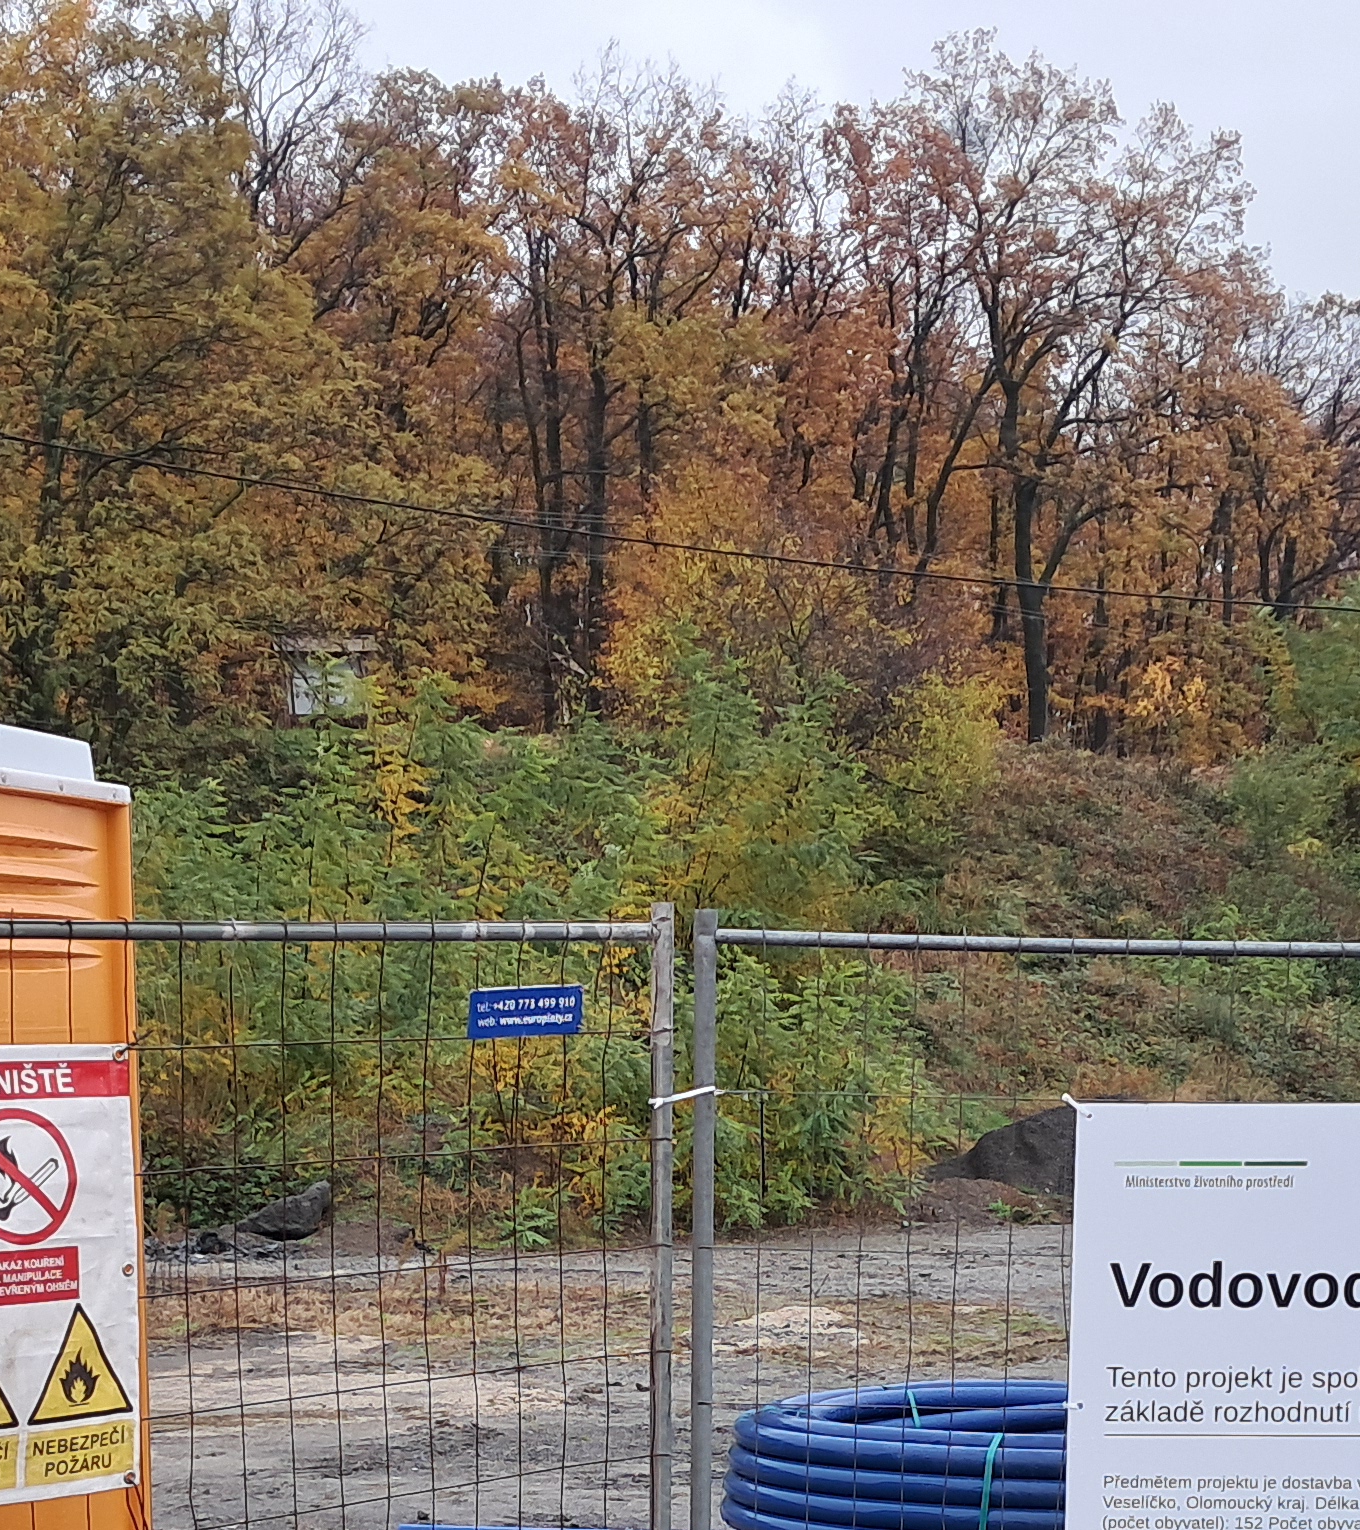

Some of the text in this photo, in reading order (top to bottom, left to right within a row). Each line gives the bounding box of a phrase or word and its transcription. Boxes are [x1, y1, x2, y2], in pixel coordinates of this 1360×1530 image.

[1126, 1175, 1293, 1190] Ministerstvo životního prostředí
[24, 1255, 64, 1269] KOUŘENÍ
[3, 1270, 63, 1282] MANIPULACE
[1106, 1367, 1175, 1387] Tento
[1186, 1366, 1272, 1393] projekt
[1279, 1366, 1302, 1393] je
[1105, 1400, 1203, 1422] základě
[1215, 1401, 1351, 1422] rozhodnutí
[32, 1426, 126, 1457] NEBEZPEČÍ
[45, 1453, 112, 1477] POŽÁRU
[1104, 1475, 1191, 1488] Předmětem
[1198, 1475, 1258, 1492] projektu
[1263, 1476, 1276, 1492] je
[1282, 1476, 1352, 1489] dostavba
[1103, 1495, 1180, 1511] Veselíčko,
[1187, 1496, 1272, 1512] Olomoucký
[1278, 1496, 1308, 1513] kraj.
[1316, 1496, 1359, 1509] Délka
[1235, 1517, 1262, 1529] 152
[1269, 1517, 1312, 1530] Počet
